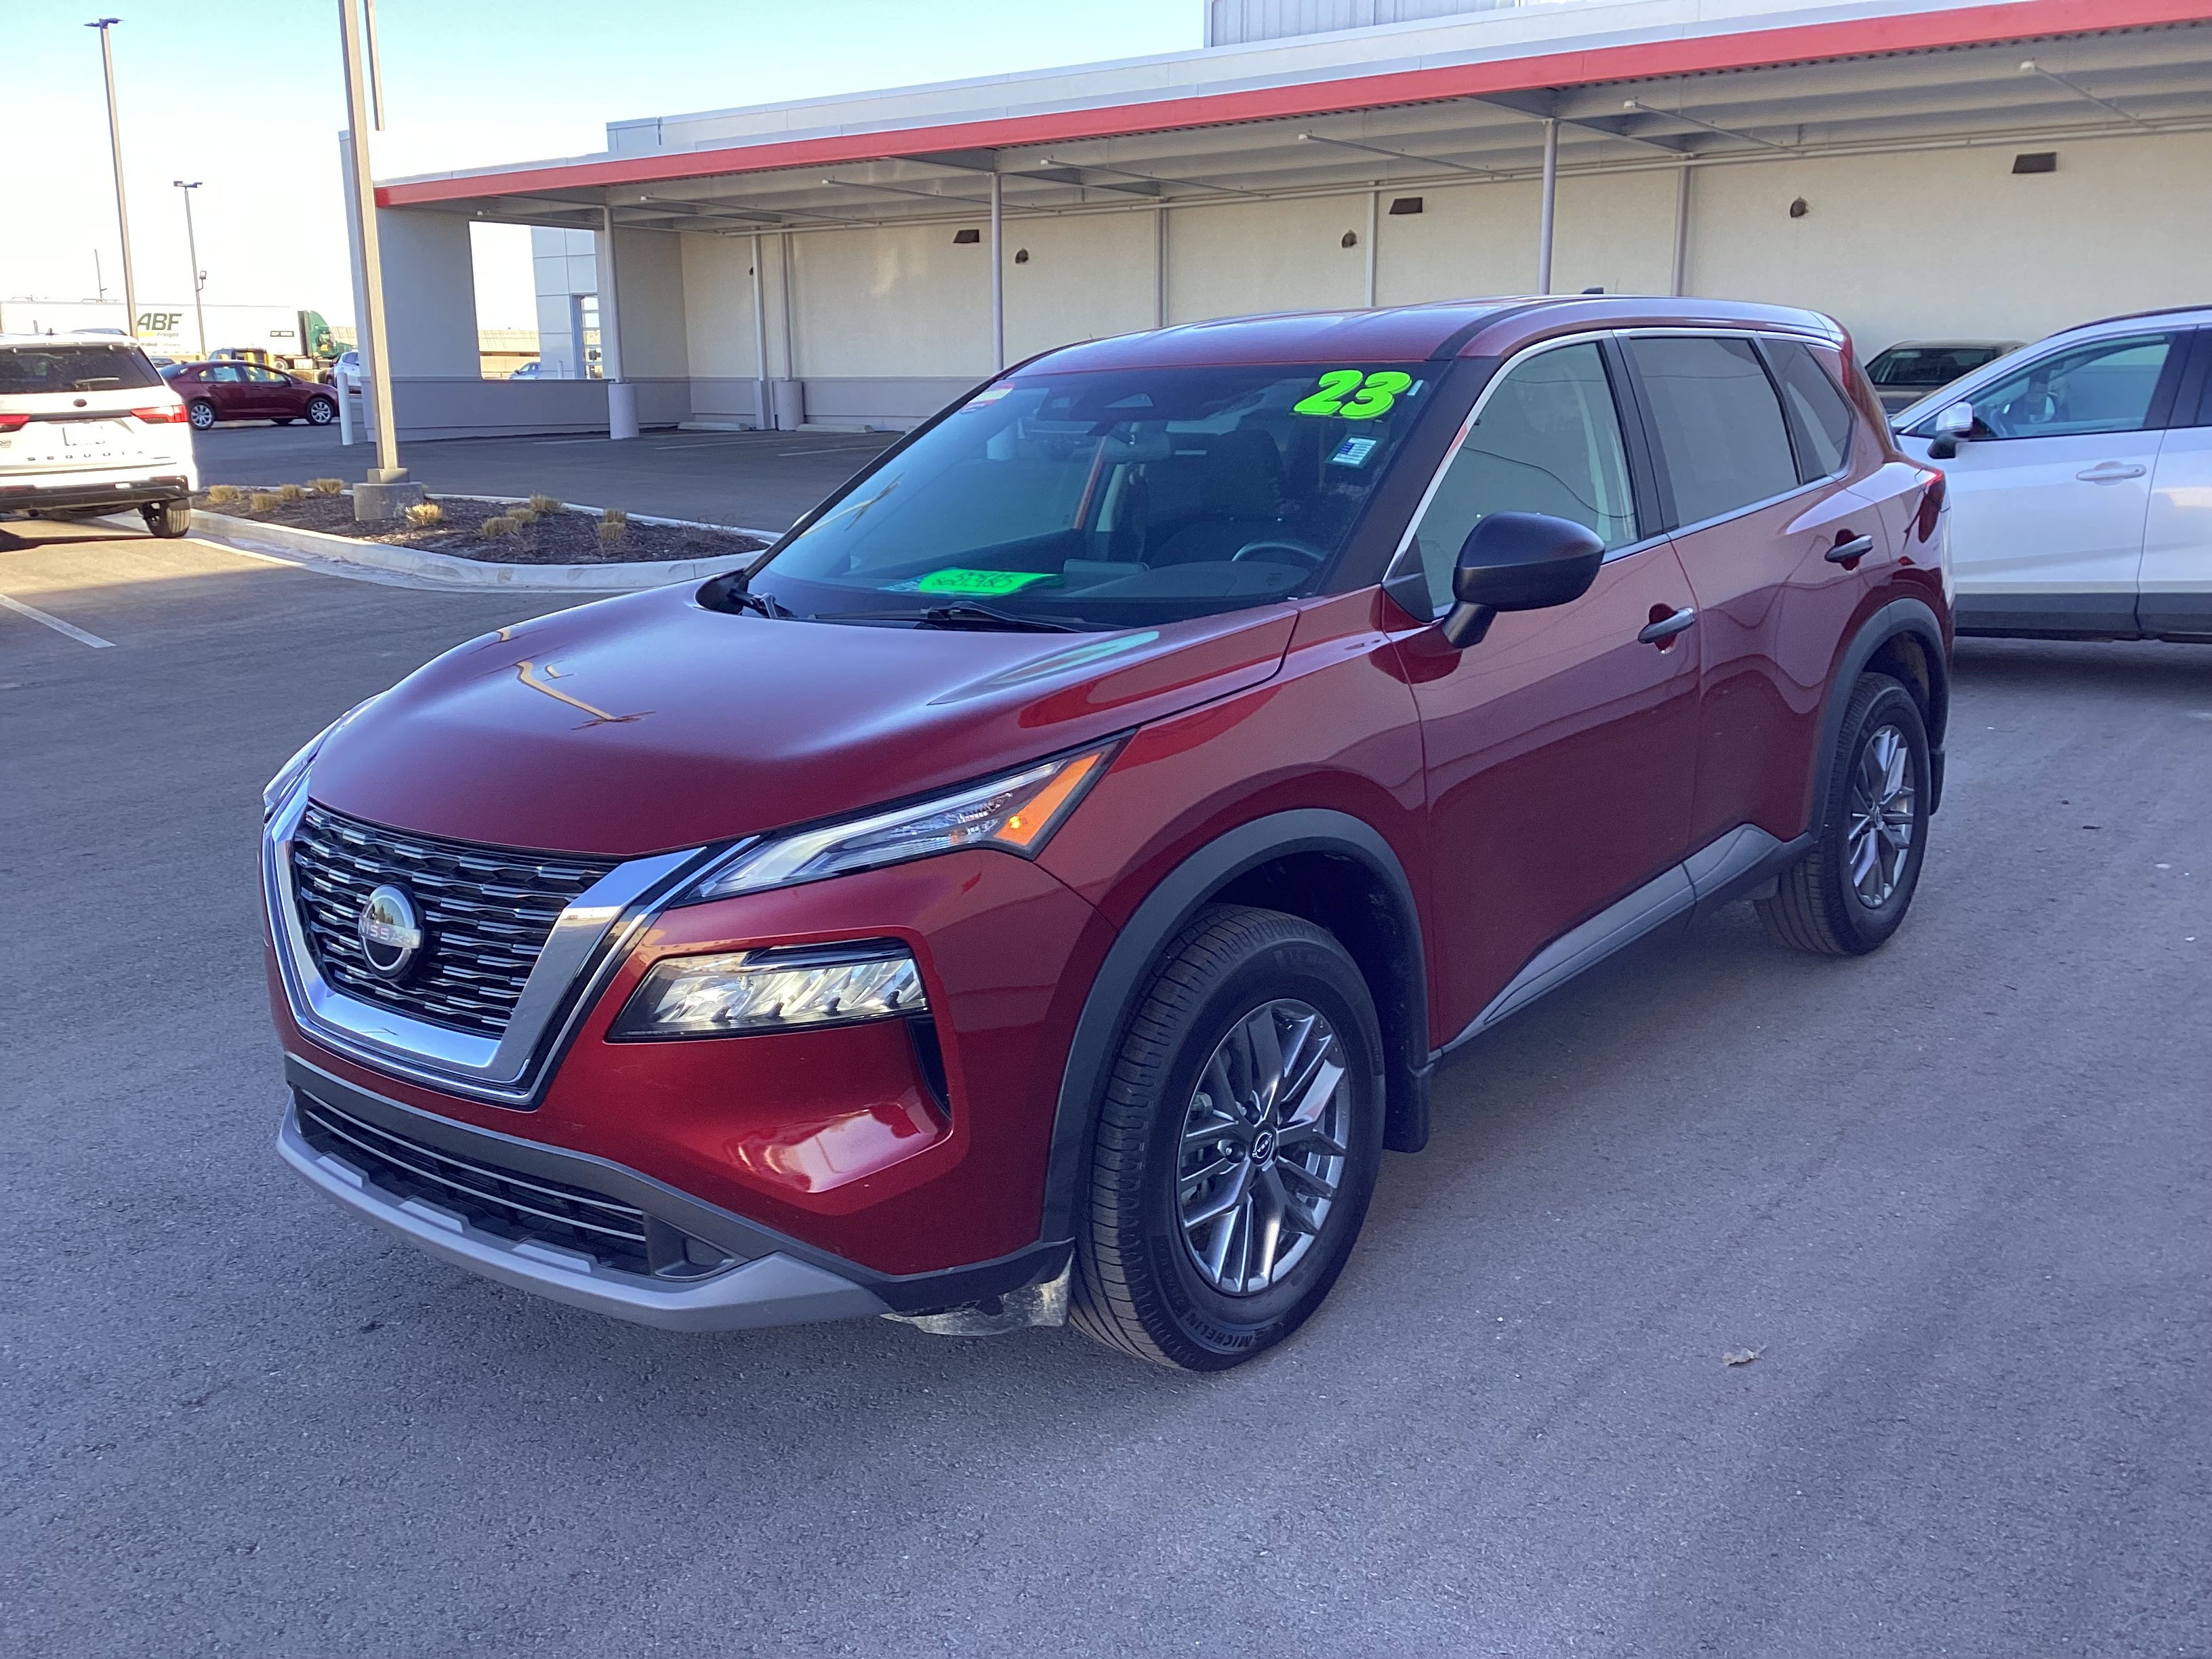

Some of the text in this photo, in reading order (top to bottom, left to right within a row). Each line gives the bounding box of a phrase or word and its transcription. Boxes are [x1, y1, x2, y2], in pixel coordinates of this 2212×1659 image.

[136, 312, 182, 331] ABF
[1293, 369, 1412, 419] 23
[1186, 1311, 1253, 1348] MICHELIN
